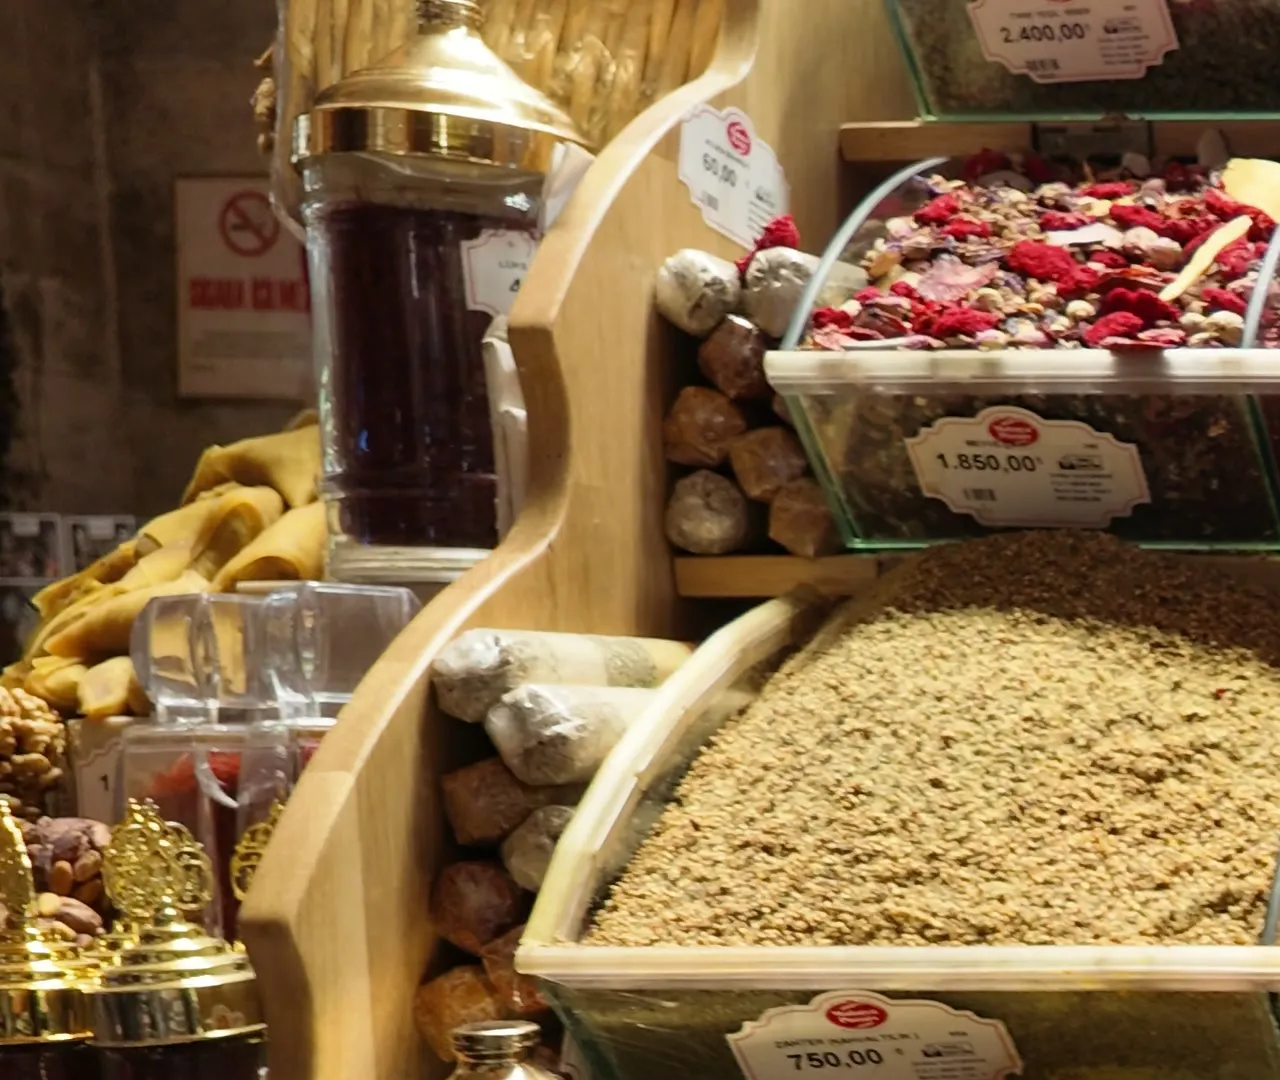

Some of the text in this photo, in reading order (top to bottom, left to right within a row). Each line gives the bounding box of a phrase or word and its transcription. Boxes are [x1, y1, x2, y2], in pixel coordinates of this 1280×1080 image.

[1000, 23, 1085, 43] 2.400,00
[937, 453, 1036, 472] 1.850,00
[787, 1048, 883, 1071] 750,00
